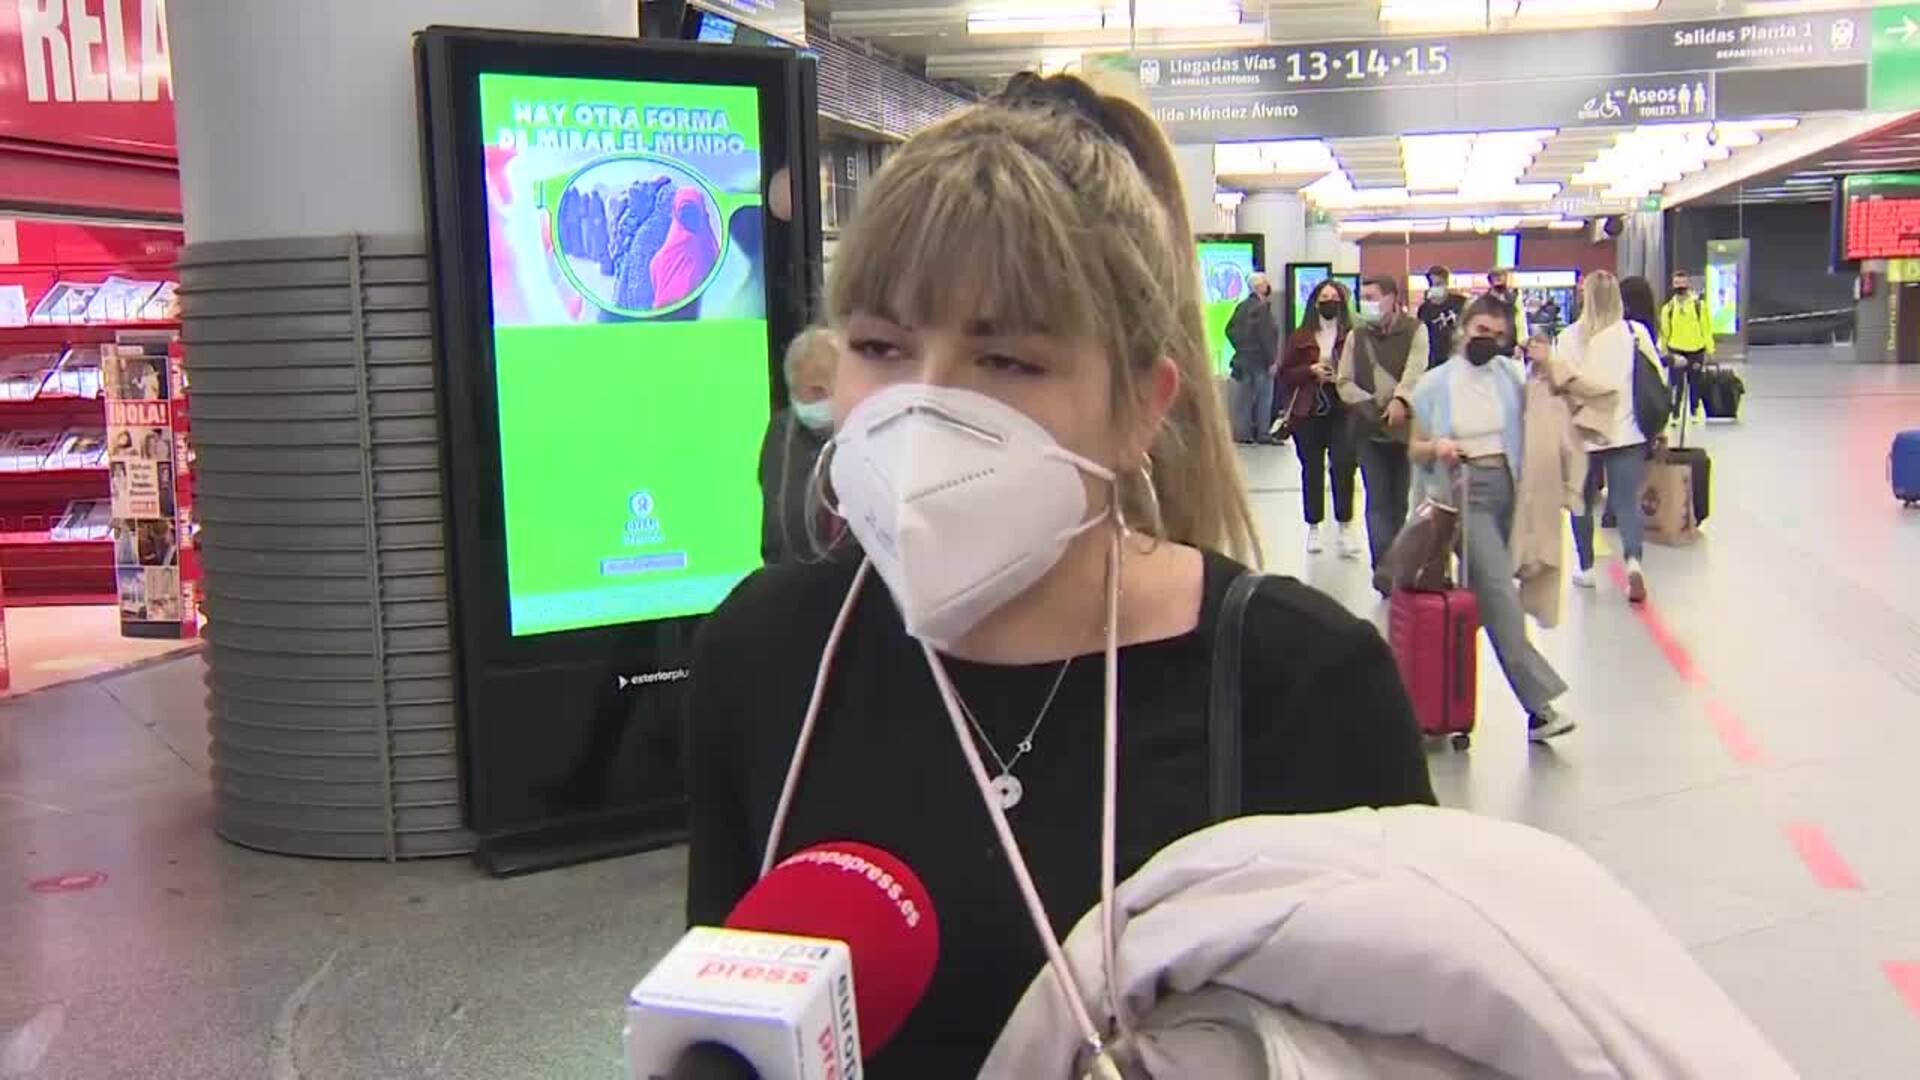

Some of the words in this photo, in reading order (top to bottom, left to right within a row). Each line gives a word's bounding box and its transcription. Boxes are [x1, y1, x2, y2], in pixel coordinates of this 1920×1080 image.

[1674, 28, 1736, 46] Salidas
[1740, 23, 1796, 41] Planta
[1803, 21, 1812, 37] 1
[1170, 56, 1239, 74] Llegadas
[1244, 54, 1277, 71] Vías
[1628, 87, 1677, 104] Aseos
[514, 102, 567, 125] HAY
[575, 104, 639, 130] OTRA
[644, 107, 729, 131] FORMA
[1189, 103, 1248, 120] Méndez
[1251, 100, 1298, 119] Álvaro
[536, 129, 616, 152] MIRAR
[624, 132, 648, 153] EL
[655, 133, 745, 155] MUNDO
[697, 960, 811, 986] press
